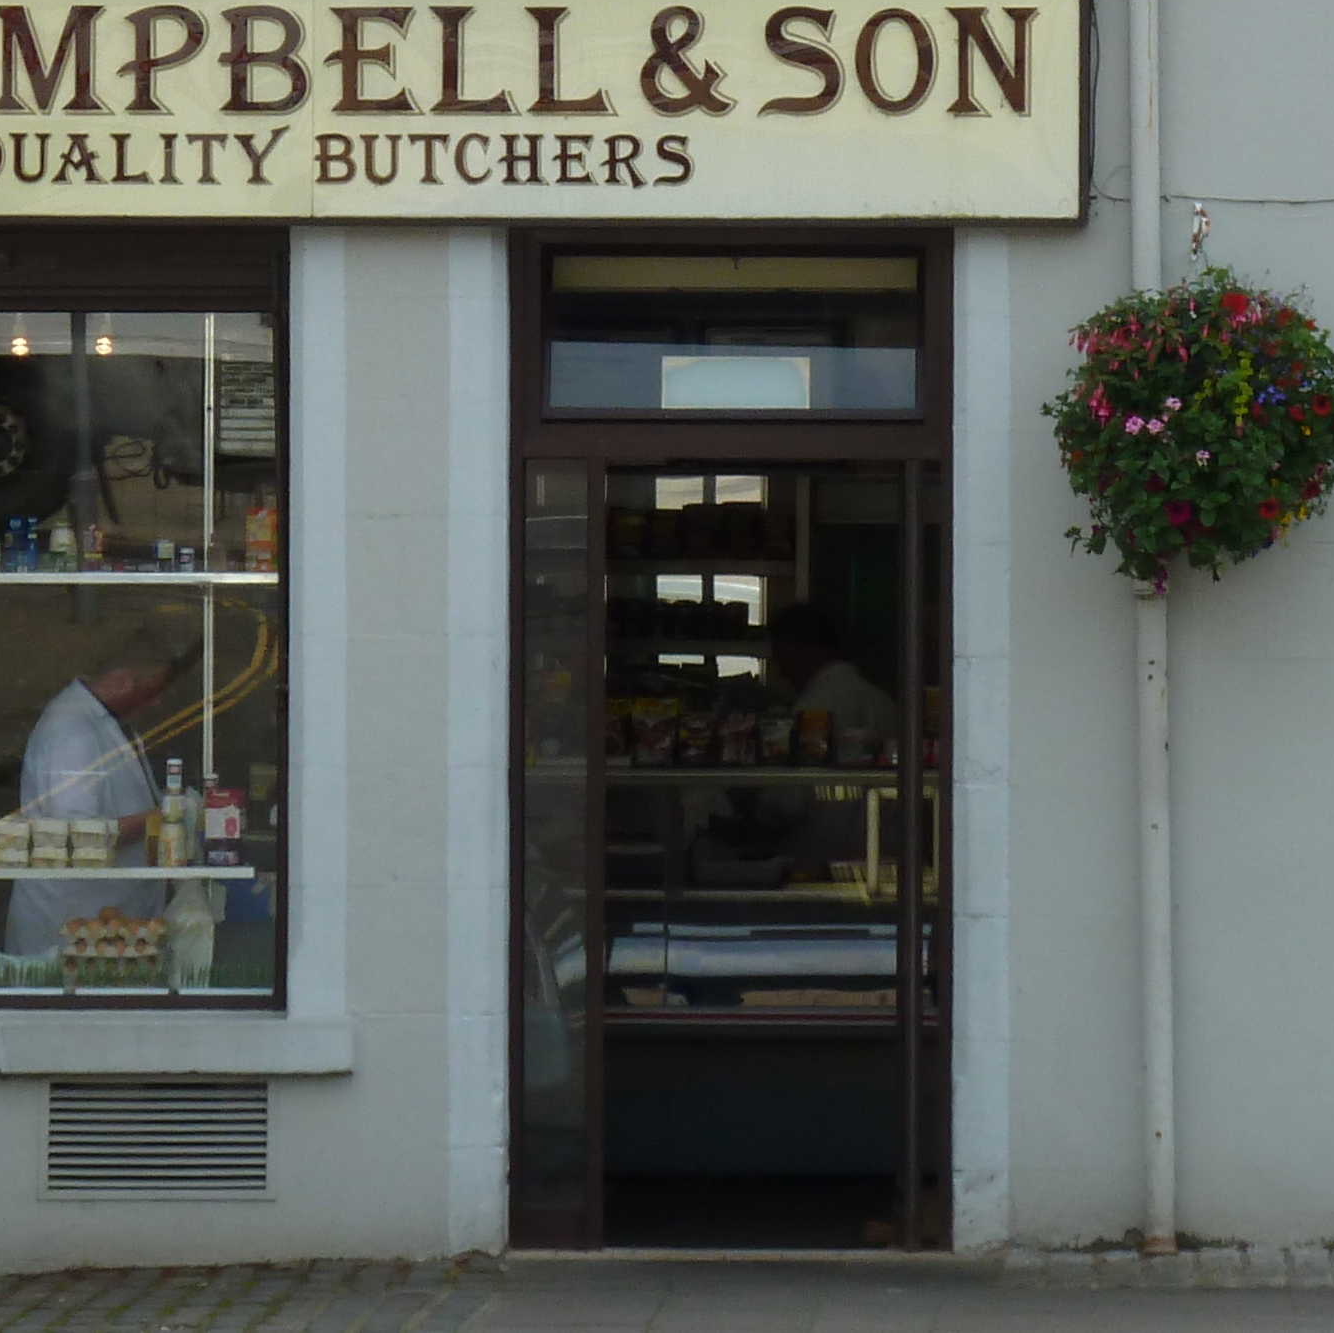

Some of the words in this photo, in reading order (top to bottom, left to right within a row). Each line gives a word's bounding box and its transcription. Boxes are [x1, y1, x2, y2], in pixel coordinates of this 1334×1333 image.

[639, 5, 738, 118] &
[757, 5, 1040, 118] SON
[314, 132, 695, 189] BUTCHERS
